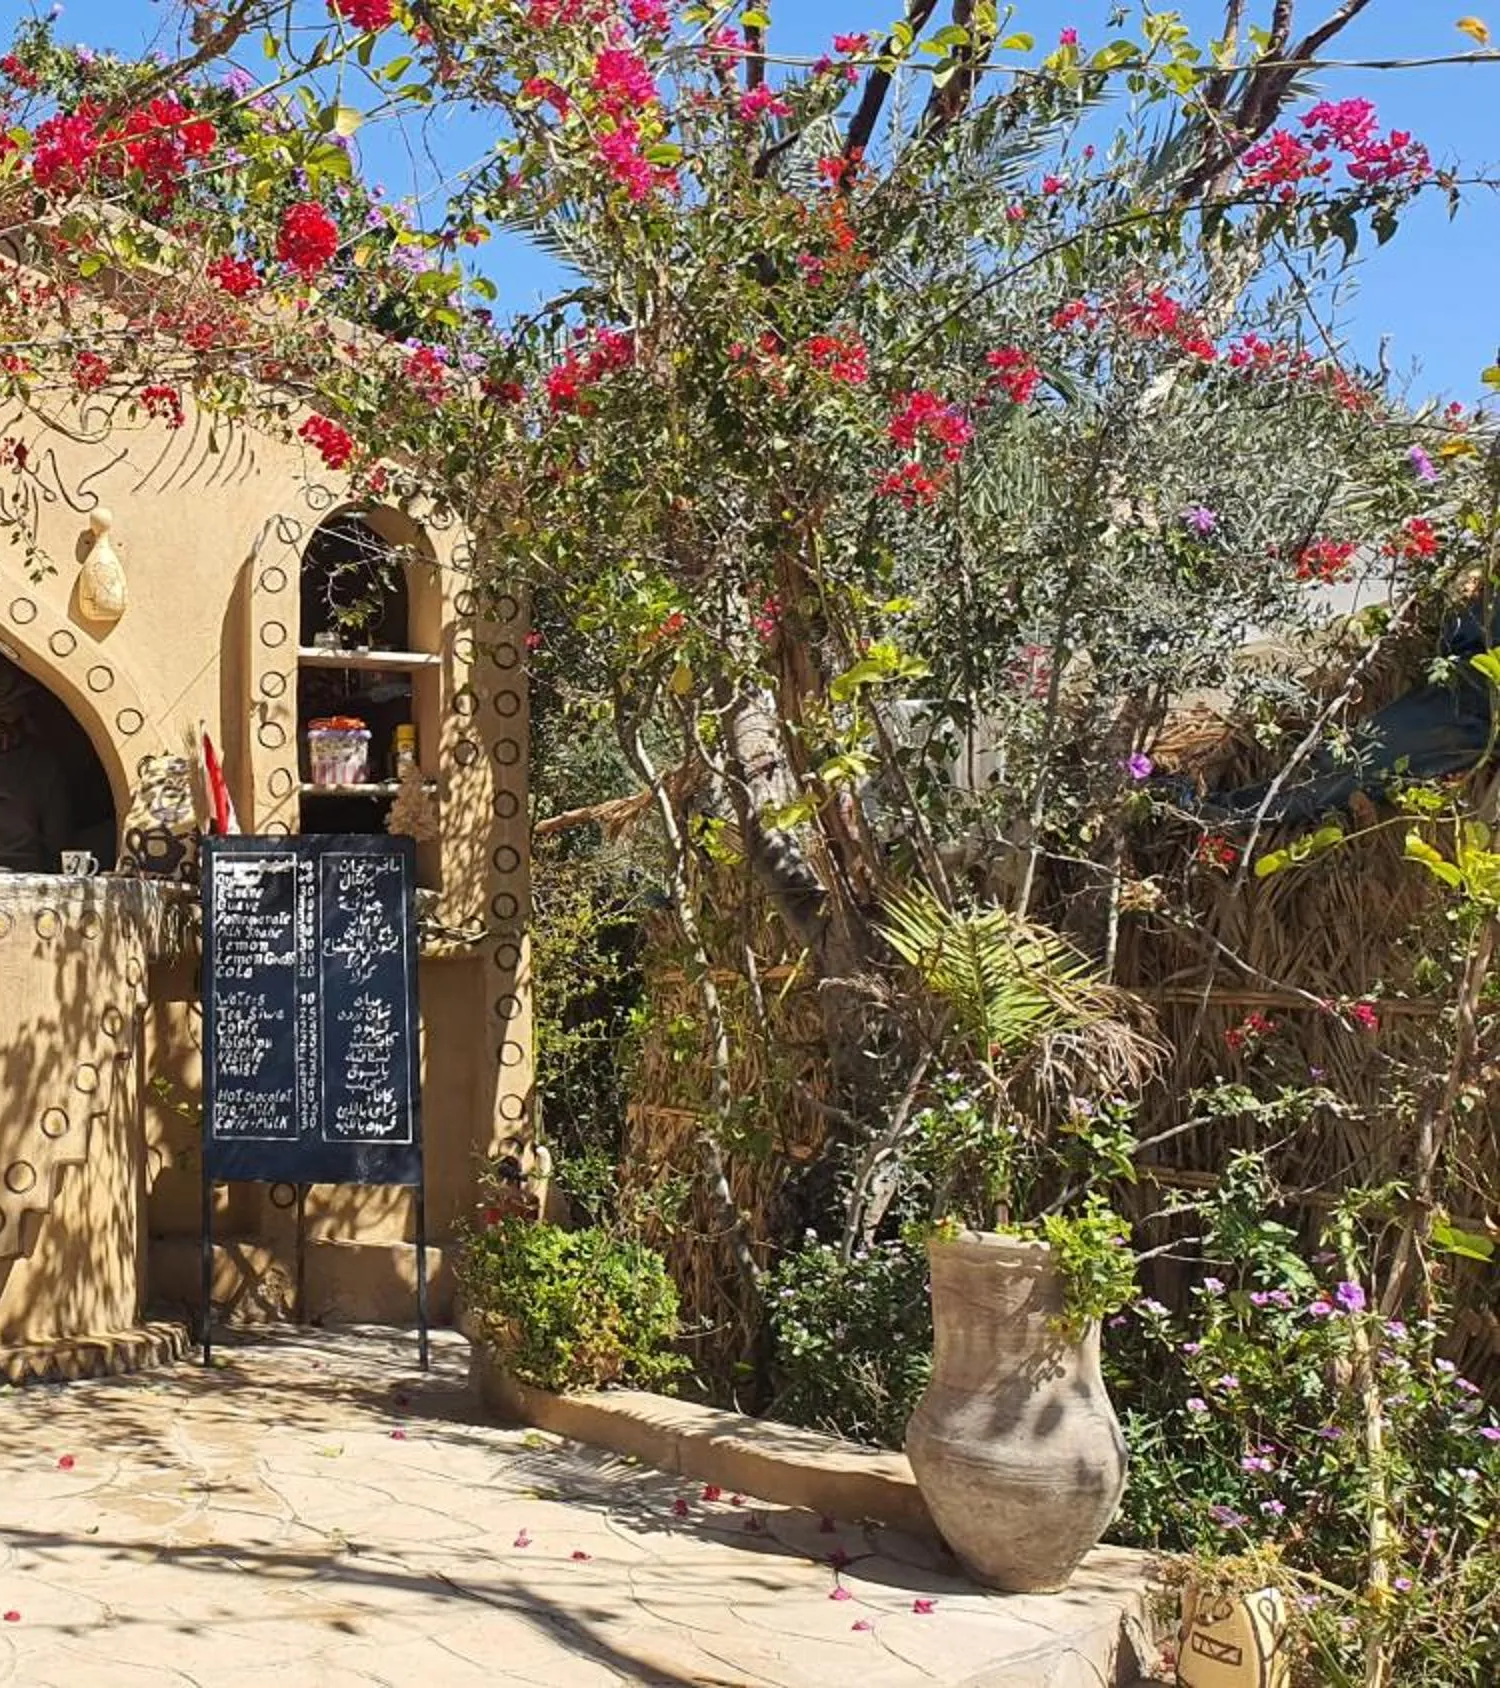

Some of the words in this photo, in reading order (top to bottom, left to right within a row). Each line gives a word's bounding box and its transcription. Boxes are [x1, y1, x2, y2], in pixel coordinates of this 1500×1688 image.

[216, 938, 269, 952] Lemon
[216, 965, 253, 979] Cola
[299, 965, 315, 977] 20
[299, 991, 315, 1005] 10
[216, 1007, 241, 1021] Tea
[299, 1007, 317, 1020] 25
